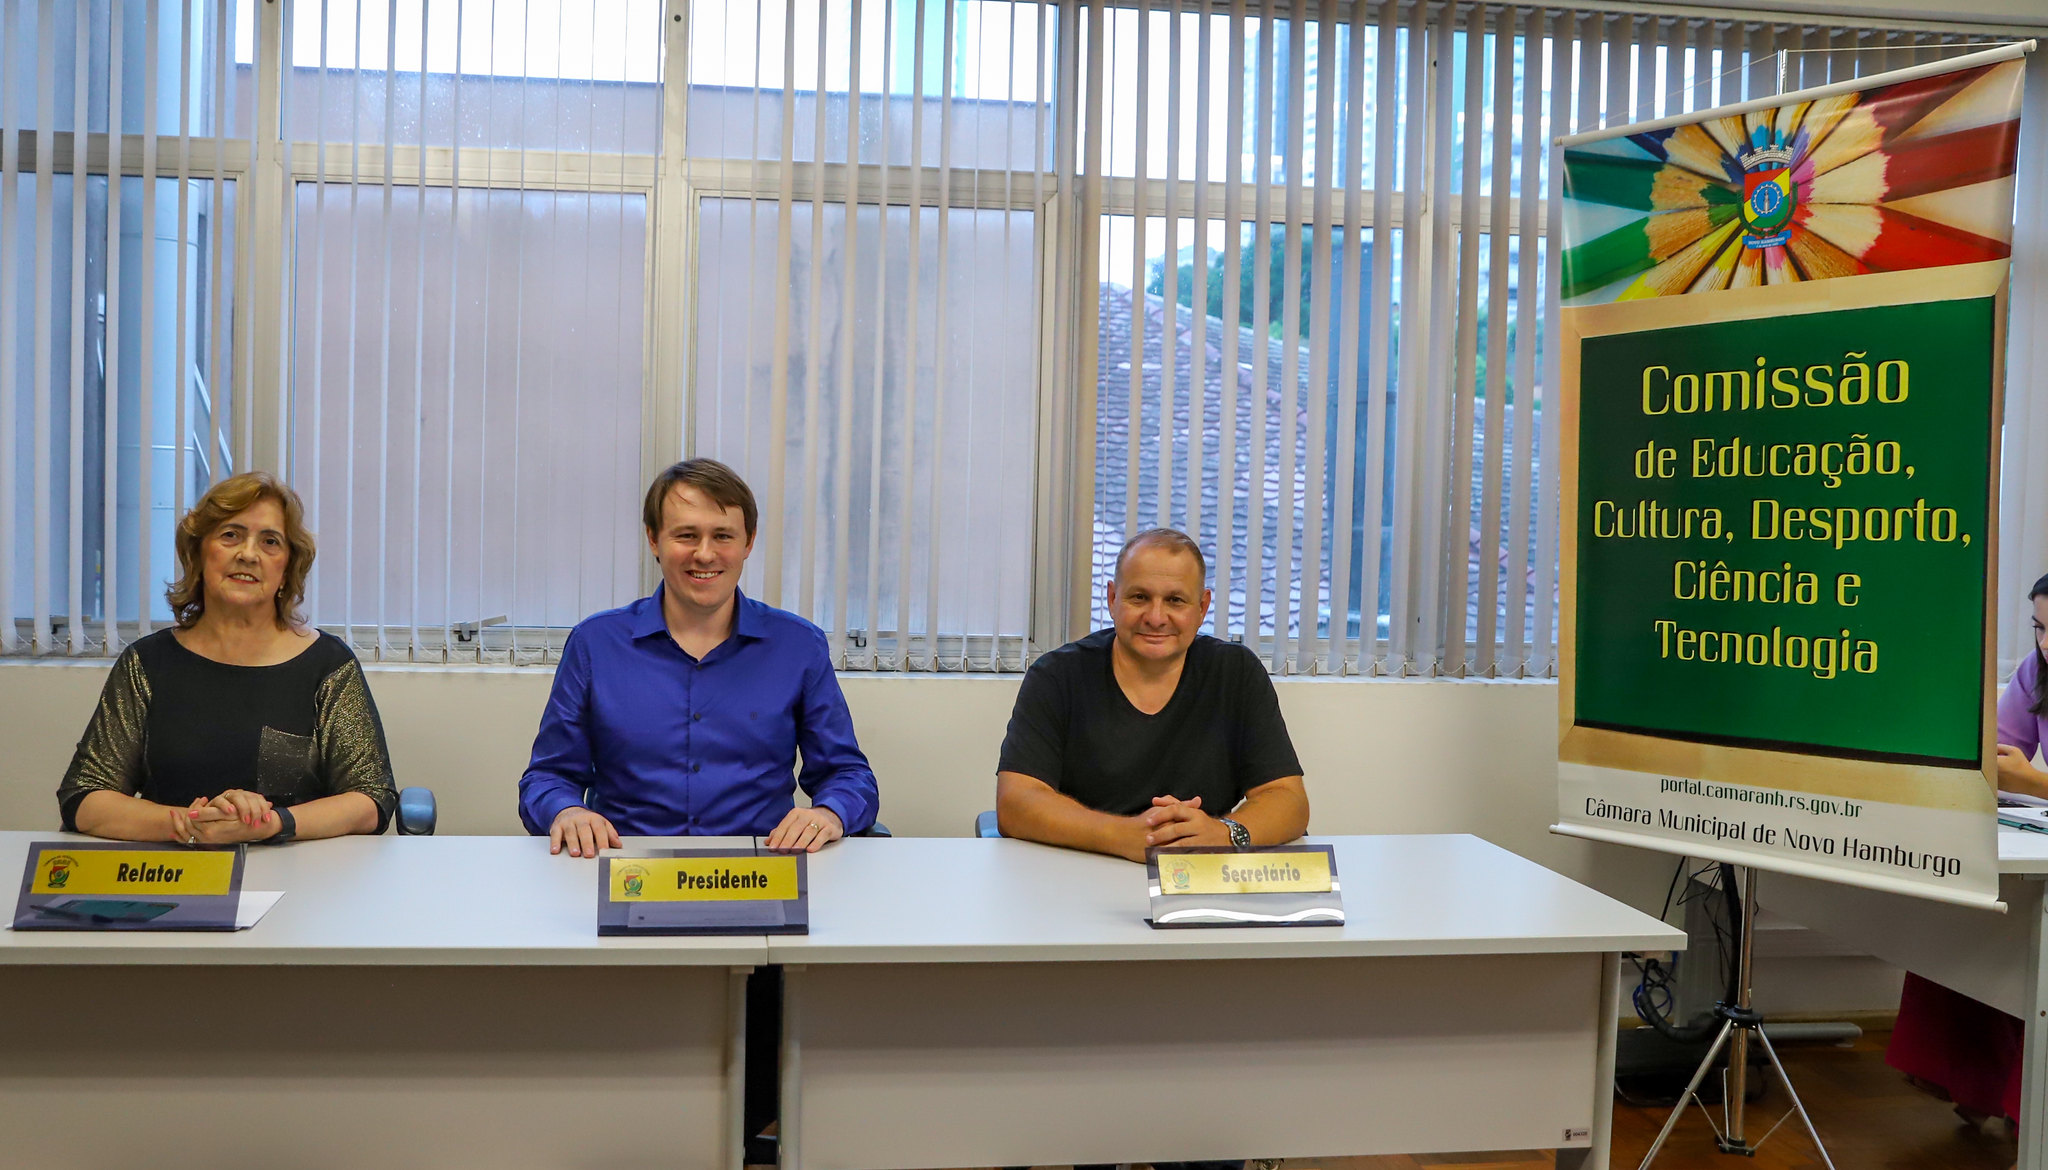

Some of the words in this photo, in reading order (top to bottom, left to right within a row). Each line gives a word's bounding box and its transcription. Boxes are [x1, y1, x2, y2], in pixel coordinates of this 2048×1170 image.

[1642, 351, 1910, 416] Comissão
[1634, 440, 1677, 479] de
[1692, 433, 1915, 489] Educação,
[1594, 500, 1734, 544] Cultura,
[1752, 498, 1971, 550] Desporto,
[1674, 560, 1819, 605] Ciência
[1837, 573, 1861, 607] e
[1654, 620, 1878, 680] Tecnologia
[1660, 776, 1863, 818] portal.camaranh.rs.gov.br
[1585, 797, 1652, 826] Câmara
[1658, 808, 1746, 842] Municipal
[1753, 823, 1777, 846] de
[1784, 828, 1835, 855] Novo
[1843, 836, 1961, 878] Hamburgo
[116, 861, 184, 883] Relator
[677, 868, 768, 890] Presidente
[1221, 862, 1301, 883] Secretário
